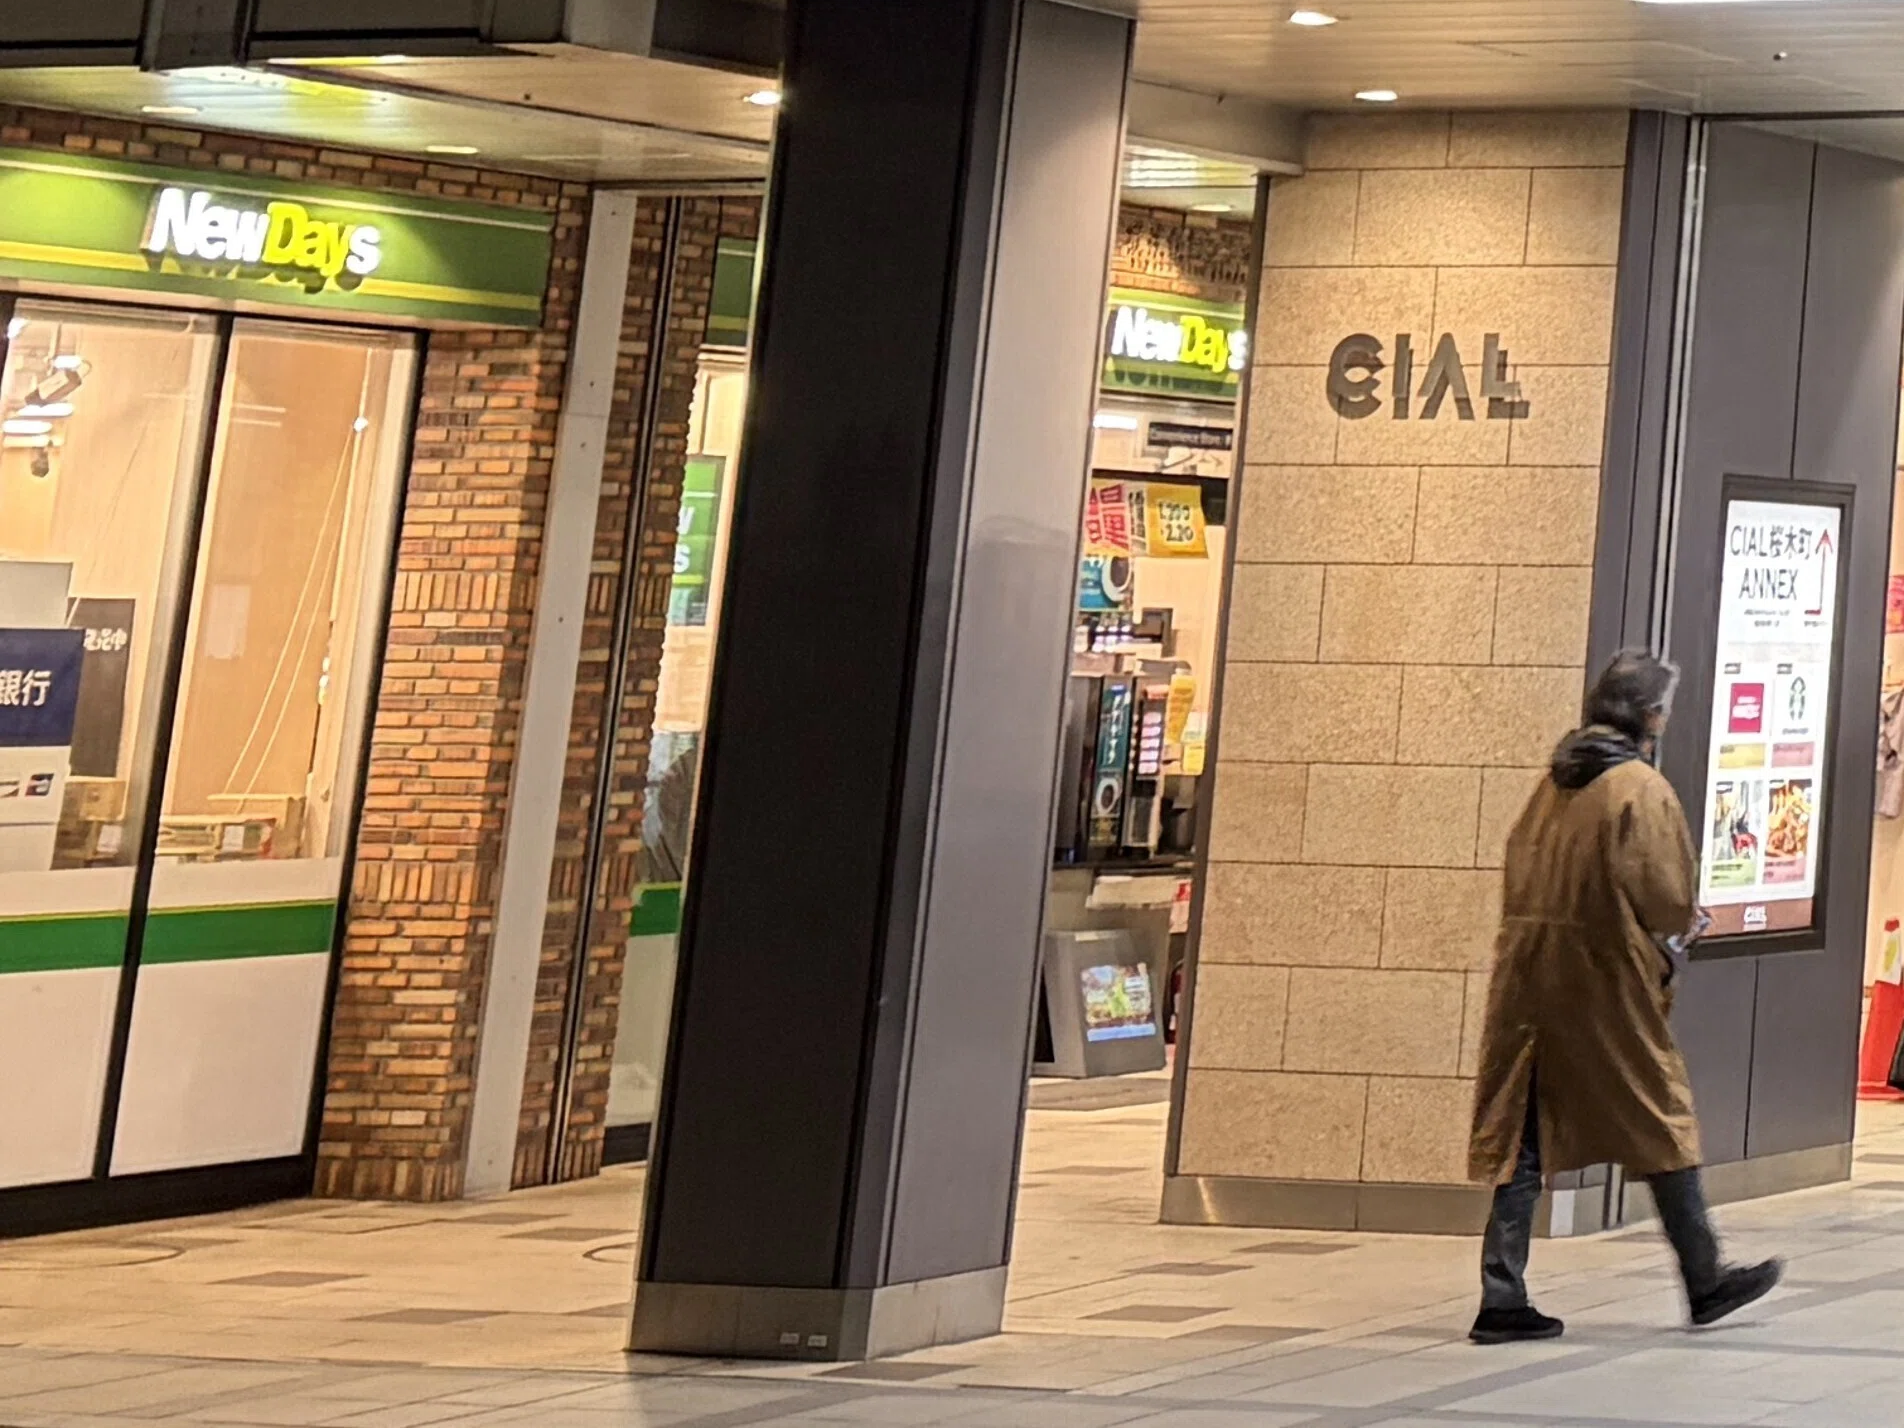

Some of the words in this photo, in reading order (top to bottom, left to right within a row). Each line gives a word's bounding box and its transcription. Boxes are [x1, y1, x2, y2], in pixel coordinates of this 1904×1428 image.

[149, 187, 382, 278] NewDays
[1112, 306, 1248, 374] NewDays
[1328, 333, 1526, 416] CIAL
[1738, 567, 1799, 600] ANNEX
